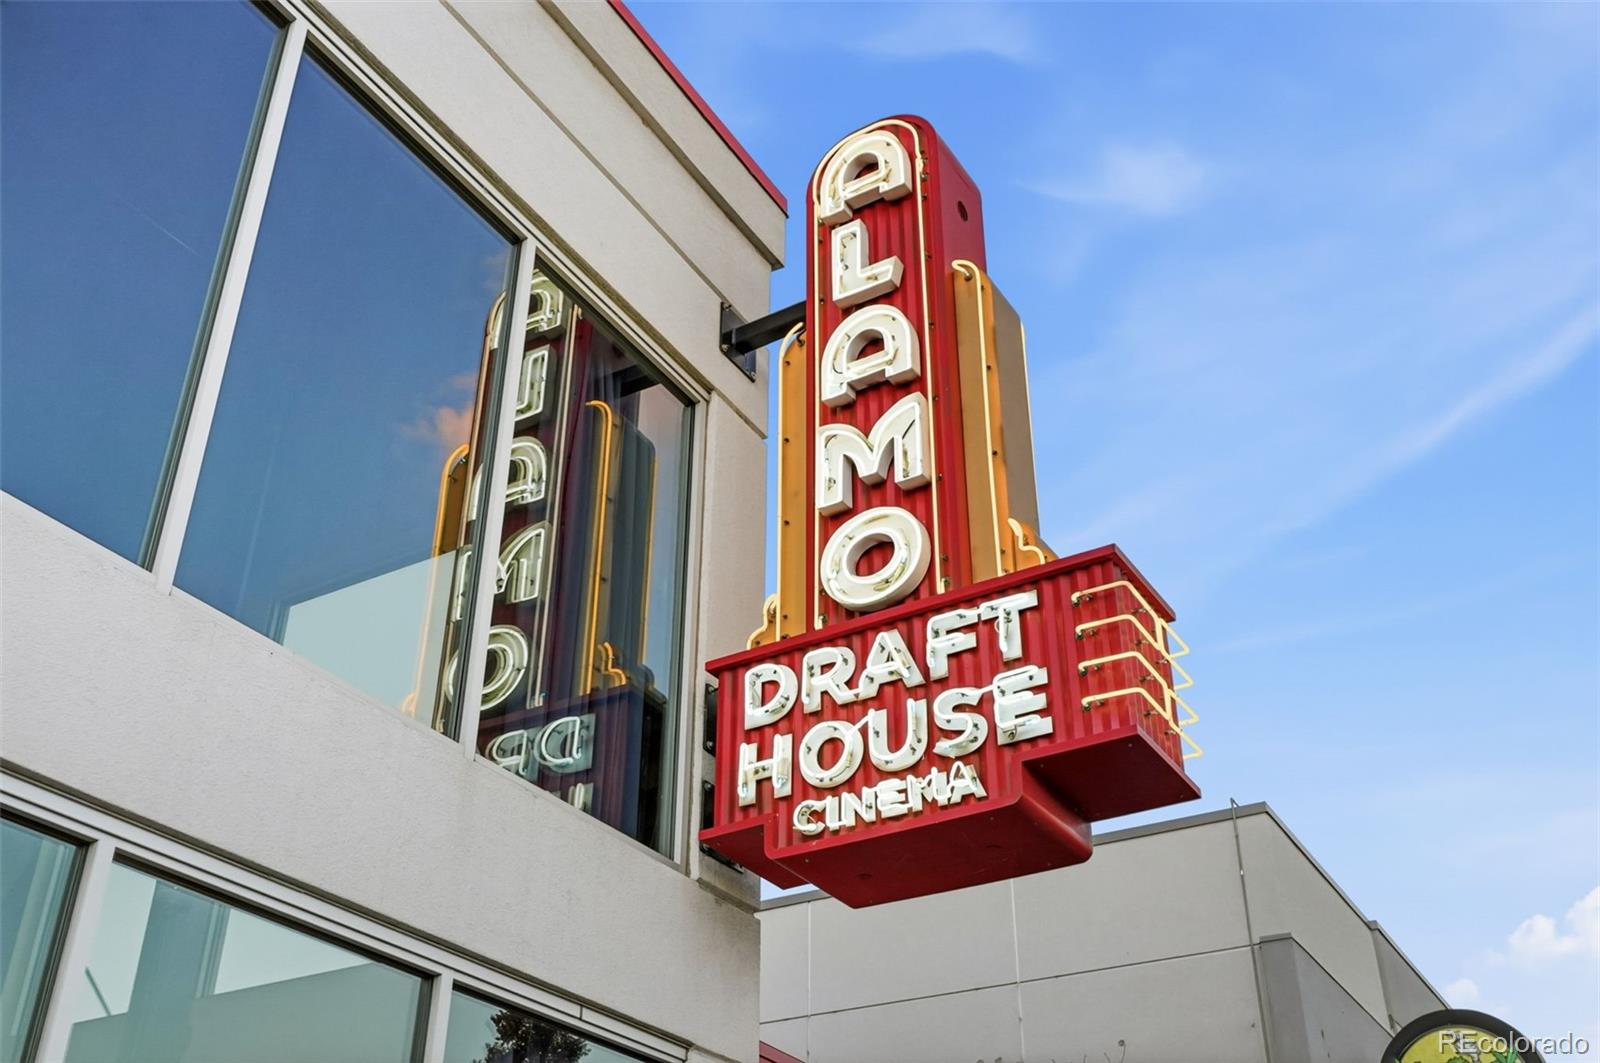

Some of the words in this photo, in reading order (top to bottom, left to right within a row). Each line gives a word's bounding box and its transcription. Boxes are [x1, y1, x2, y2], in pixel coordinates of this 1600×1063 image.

[817, 130, 931, 611] ALAMO
[744, 590, 1038, 730] DRAFT
[737, 665, 1053, 806] HOUSE
[793, 761, 987, 836] CINEMA
